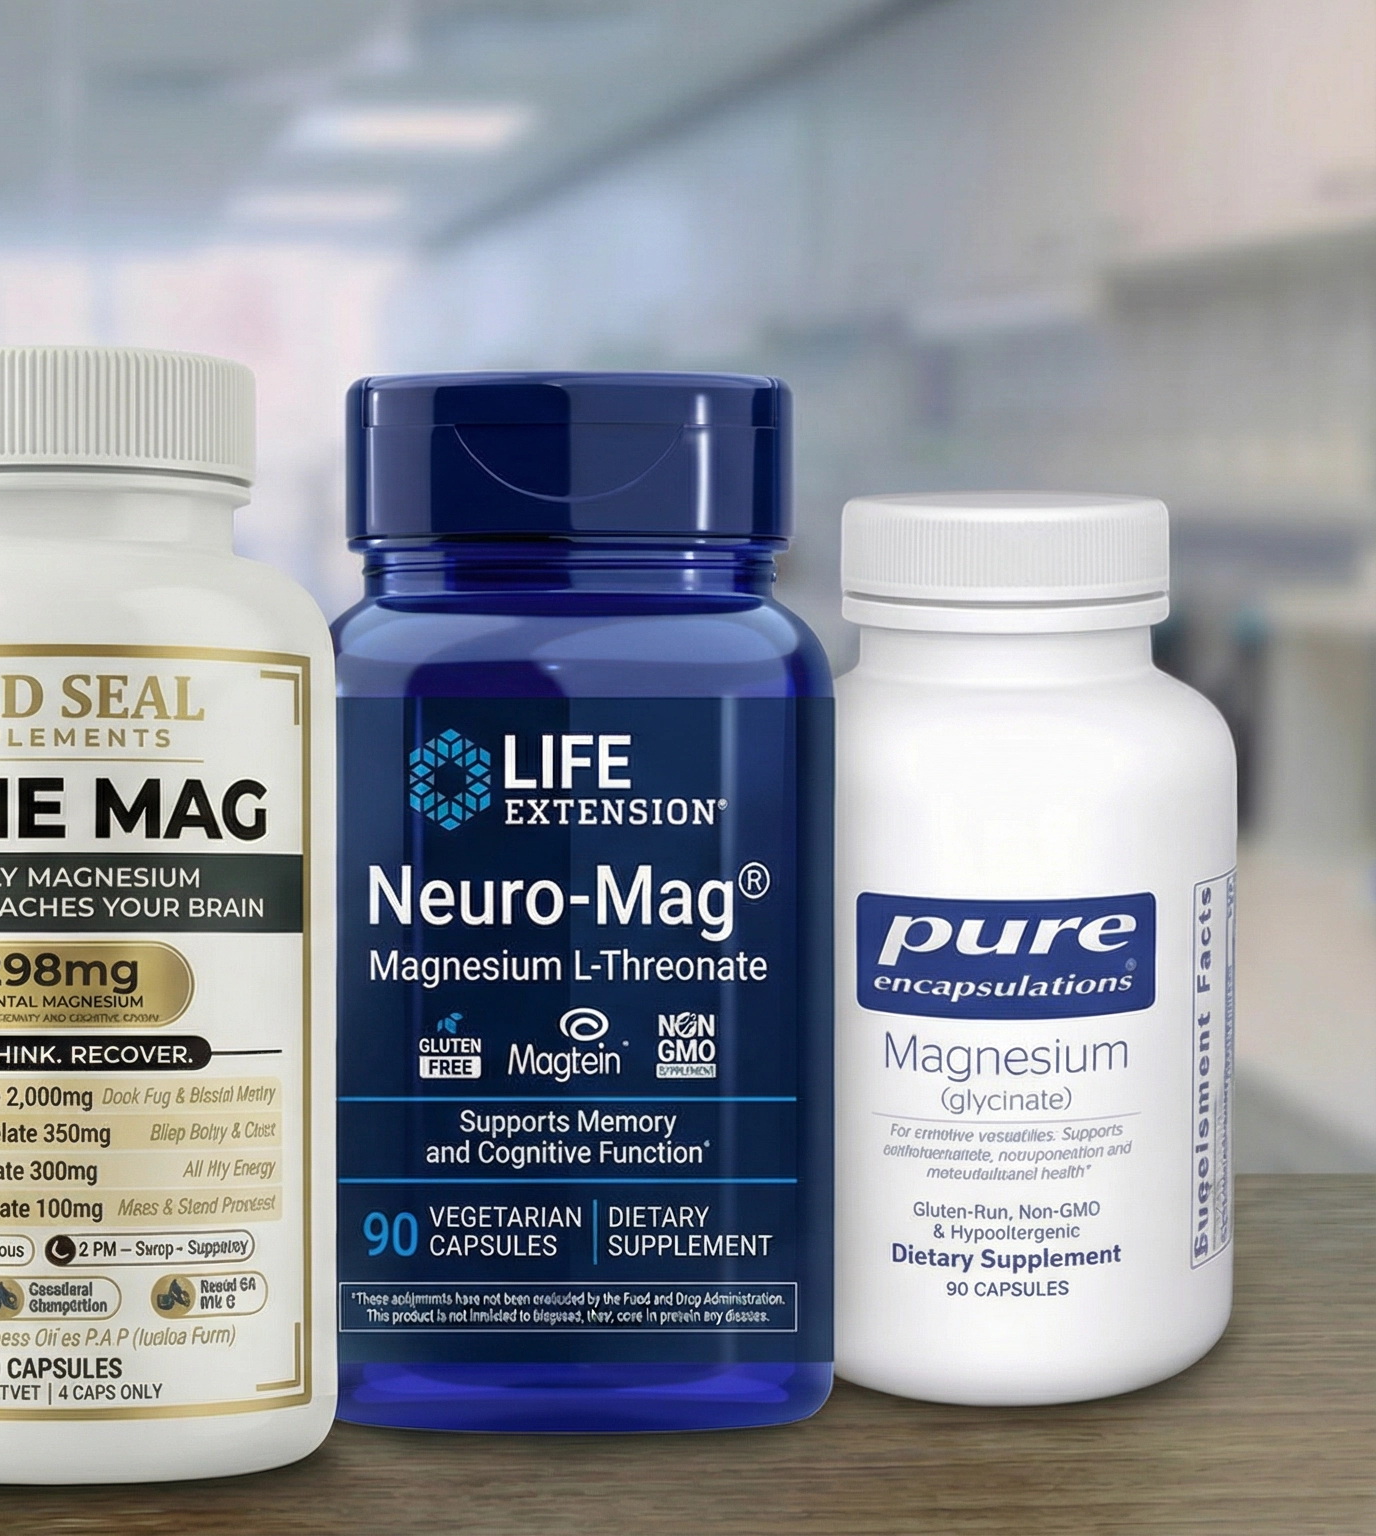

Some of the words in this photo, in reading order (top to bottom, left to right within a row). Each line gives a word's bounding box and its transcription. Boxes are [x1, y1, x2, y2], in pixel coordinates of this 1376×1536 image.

[62, 675, 205, 721] SEAL
[505, 735, 631, 789] LIFE
[95, 779, 267, 840] MAG
[505, 800, 716, 825] EXTENSION
[27, 868, 200, 888] MAGNESIUM
[101, 898, 180, 918] YOUR
[189, 898, 263, 918] BRAIN
[878, 914, 1136, 966] pure
[1197, 887, 1212, 993] Facts
[370, 950, 562, 988] Magnesium
[575, 950, 767, 981] L-Threonate
[874, 974, 1132, 1002] encapsulations
[43, 996, 143, 1008] MAGNESIUM
[72, 1046, 192, 1063] RECOVER.
[419, 1038, 481, 1054] GLUTEN
[658, 1039, 715, 1063] GMO
[886, 1031, 1128, 1082] Magnesium
[429, 1059, 472, 1075] FREE
[508, 1043, 620, 1082] Magtein
[6, 1086, 93, 1111] 2,000mg
[176, 1087, 185, 1103] &
[941, 1086, 1071, 1115] (glycinate)
[460, 1110, 570, 1137] Supports
[578, 1111, 677, 1137] Memory
[891, 1124, 910, 1137] For
[1062, 1124, 1123, 1142] Supports
[43, 1123, 111, 1148] 350mg
[426, 1141, 469, 1164] and
[477, 1140, 591, 1168] Cognitive
[1107, 1141, 1132, 1156] and
[29, 1160, 97, 1186] 300mg
[233, 1160, 276, 1179] Energy
[36, 1198, 103, 1223] 100mg
[430, 1207, 582, 1228] VEGETARIAN
[609, 1207, 709, 1228] DIETARY
[913, 1202, 1013, 1221] Gluten-Run,
[1019, 1201, 1100, 1220] Non-GMO
[363, 1212, 418, 1257] 90
[933, 1224, 945, 1239] &
[79, 1243, 88, 1256] 2
[93, 1242, 116, 1256] PM
[430, 1235, 557, 1257] CAPSULES
[608, 1235, 773, 1257] SUPPLEMENT
[892, 1243, 974, 1273] Dietary
[981, 1245, 1121, 1273] Supplement
[604, 1292, 621, 1306] the
[654, 1292, 673, 1306] and
[947, 1282, 968, 1296] 90
[974, 1281, 1069, 1296] CAPSULES
[367, 1309, 389, 1323] This
[520, 1309, 531, 1323] to
[7, 1358, 122, 1379] CAPSULES
[58, 1385, 68, 1399] 4
[73, 1385, 116, 1400] CAPS
[121, 1384, 163, 1399] ONLY
